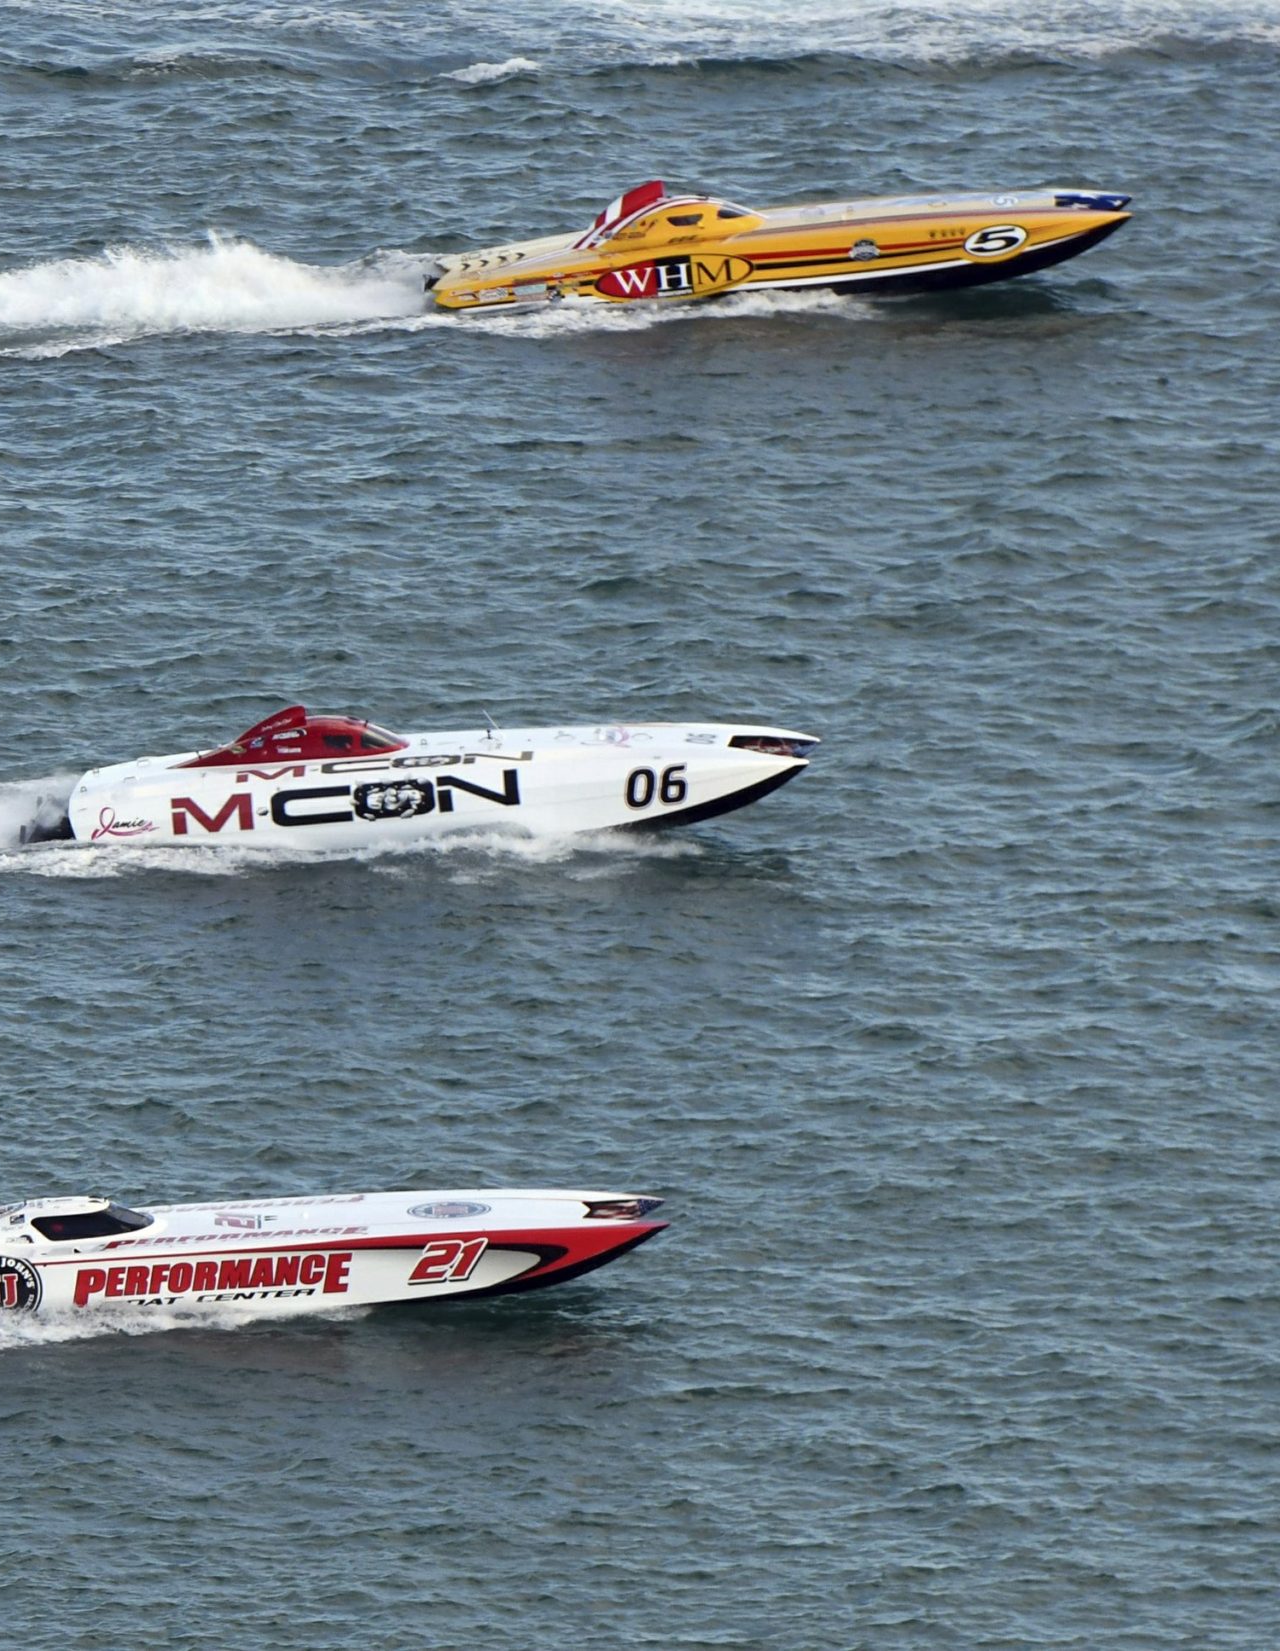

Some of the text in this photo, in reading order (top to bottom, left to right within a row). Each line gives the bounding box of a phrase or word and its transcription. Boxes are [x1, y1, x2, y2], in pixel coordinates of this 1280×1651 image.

[974, 227, 1017, 251] 5
[611, 258, 734, 294] WHM
[625, 764, 688, 810] 06
[0, 1257, 36, 1289] JOHN'S
[73, 1252, 353, 1309] PERFORMANCE
[406, 1236, 489, 1286] 21
